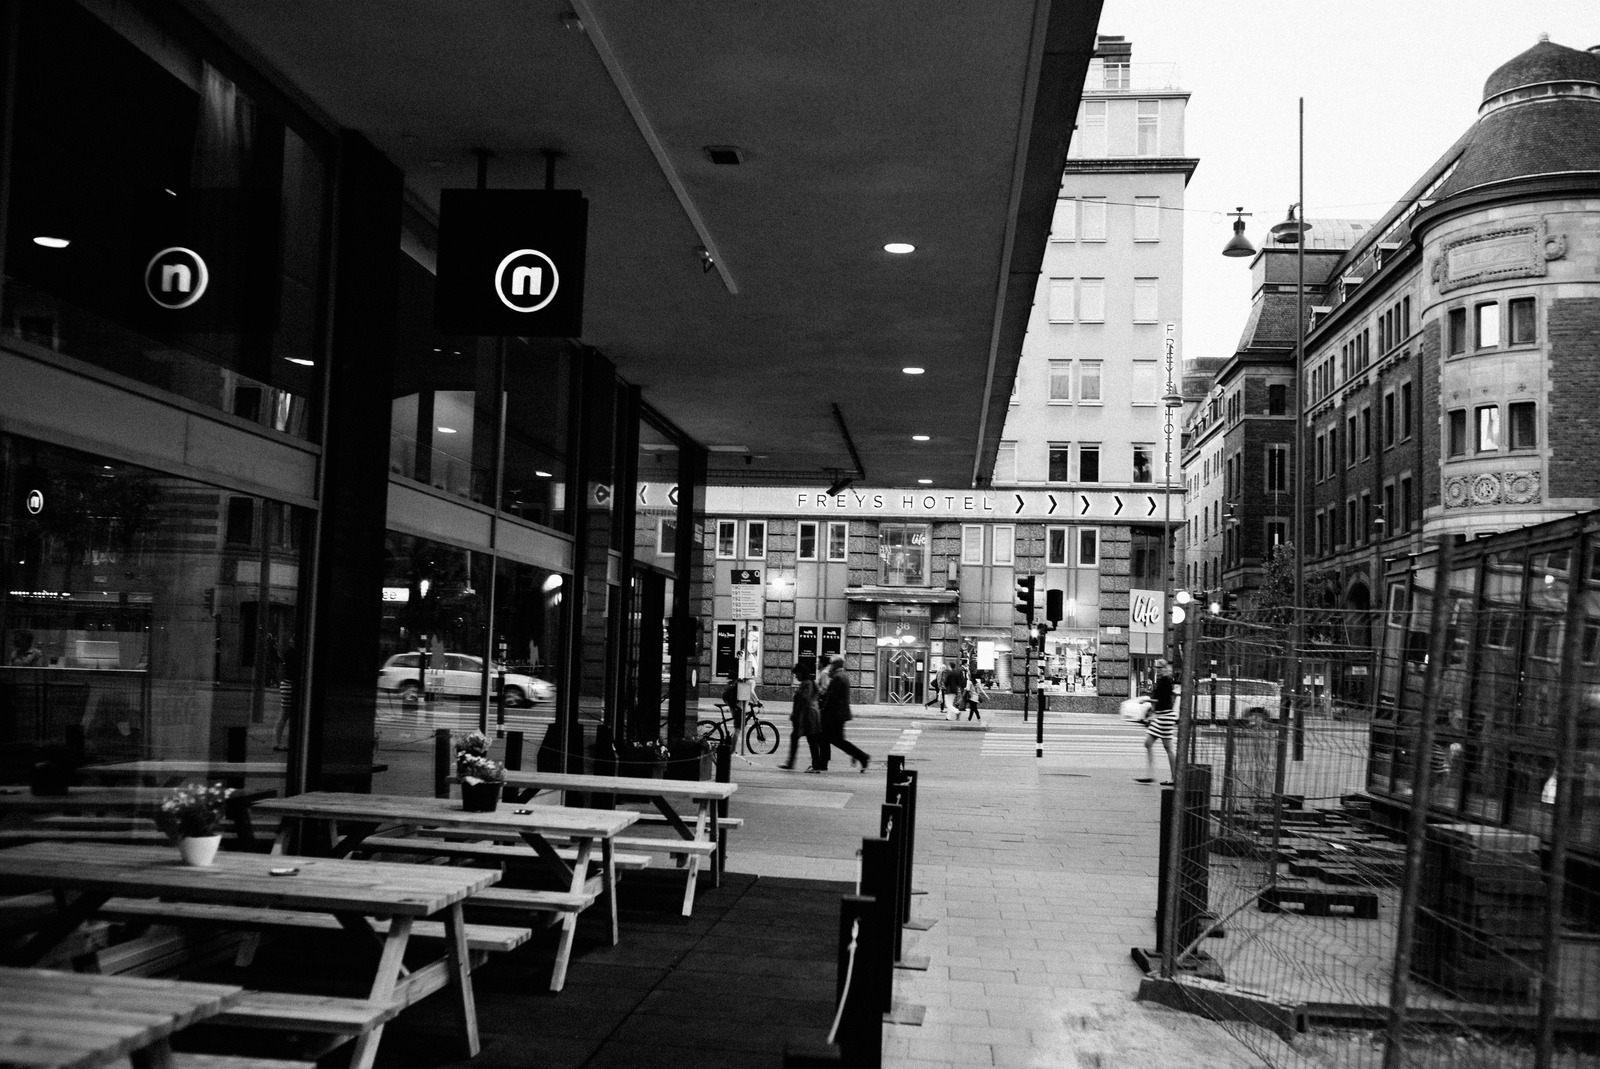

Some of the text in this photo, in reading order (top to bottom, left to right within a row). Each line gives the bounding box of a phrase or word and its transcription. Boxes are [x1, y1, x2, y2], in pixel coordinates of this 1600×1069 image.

[1163, 323, 1175, 478] FREYS HOTEL
[797, 493, 992, 511] FREYS HOTEL
[1132, 594, 1161, 627] life
[897, 622, 910, 631] 36
